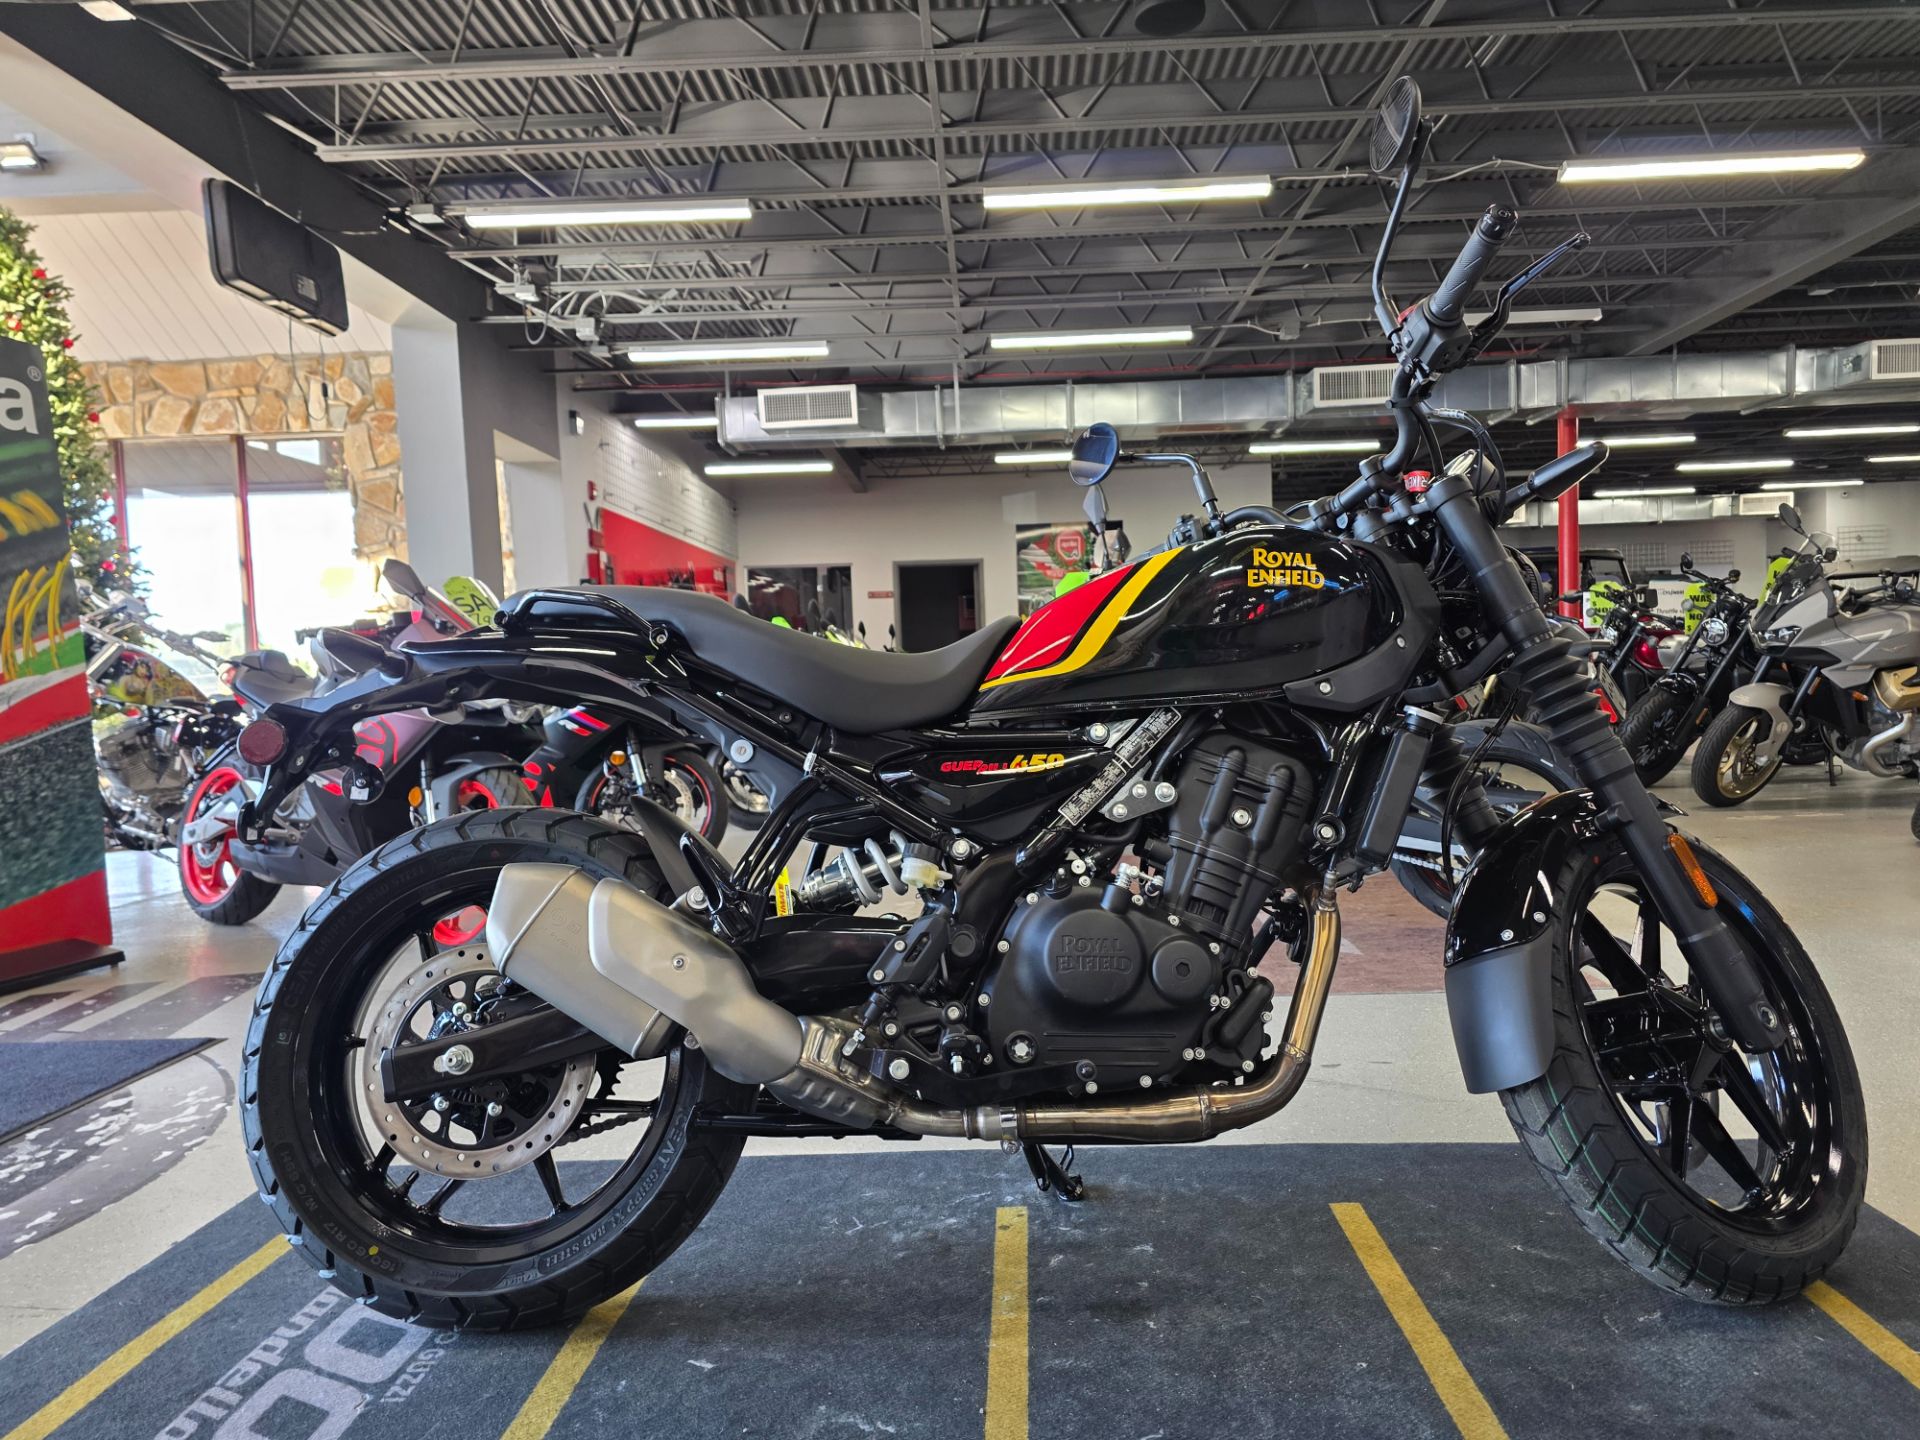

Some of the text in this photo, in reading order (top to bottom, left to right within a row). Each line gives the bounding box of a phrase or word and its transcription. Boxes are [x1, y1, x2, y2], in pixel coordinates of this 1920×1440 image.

[1252, 548, 1317, 570] ROYAL
[1247, 569, 1325, 590] ENFIELD
[1690, 594, 1712, 603] WAS
[1009, 753, 1065, 773] 450
[1061, 935, 1125, 954] ROYAL
[1056, 955, 1134, 975] ENFIELD
[658, 1106, 687, 1168] CEAT
